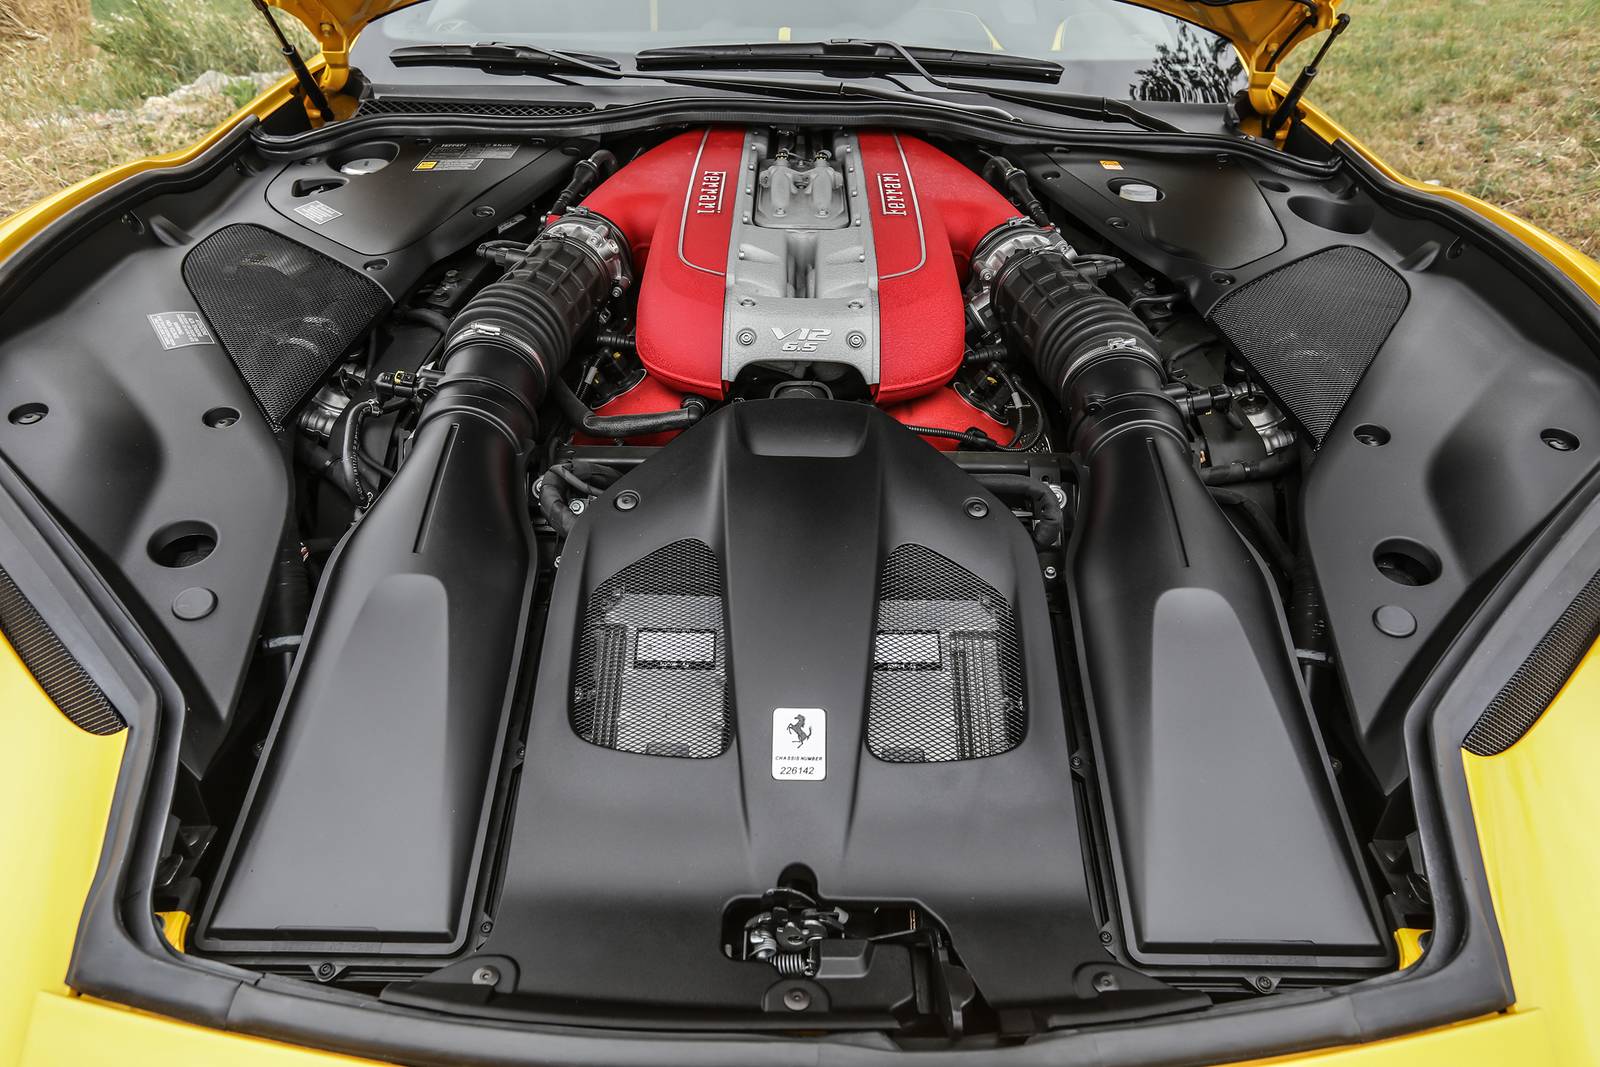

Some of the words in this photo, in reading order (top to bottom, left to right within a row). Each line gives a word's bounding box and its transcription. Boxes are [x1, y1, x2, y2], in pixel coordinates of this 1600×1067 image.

[697, 171, 726, 214] Ferrari
[877, 172, 907, 216] Ferrari
[771, 327, 832, 341] V12
[781, 342, 818, 353] 6.5
[780, 766, 815, 775] 226142
